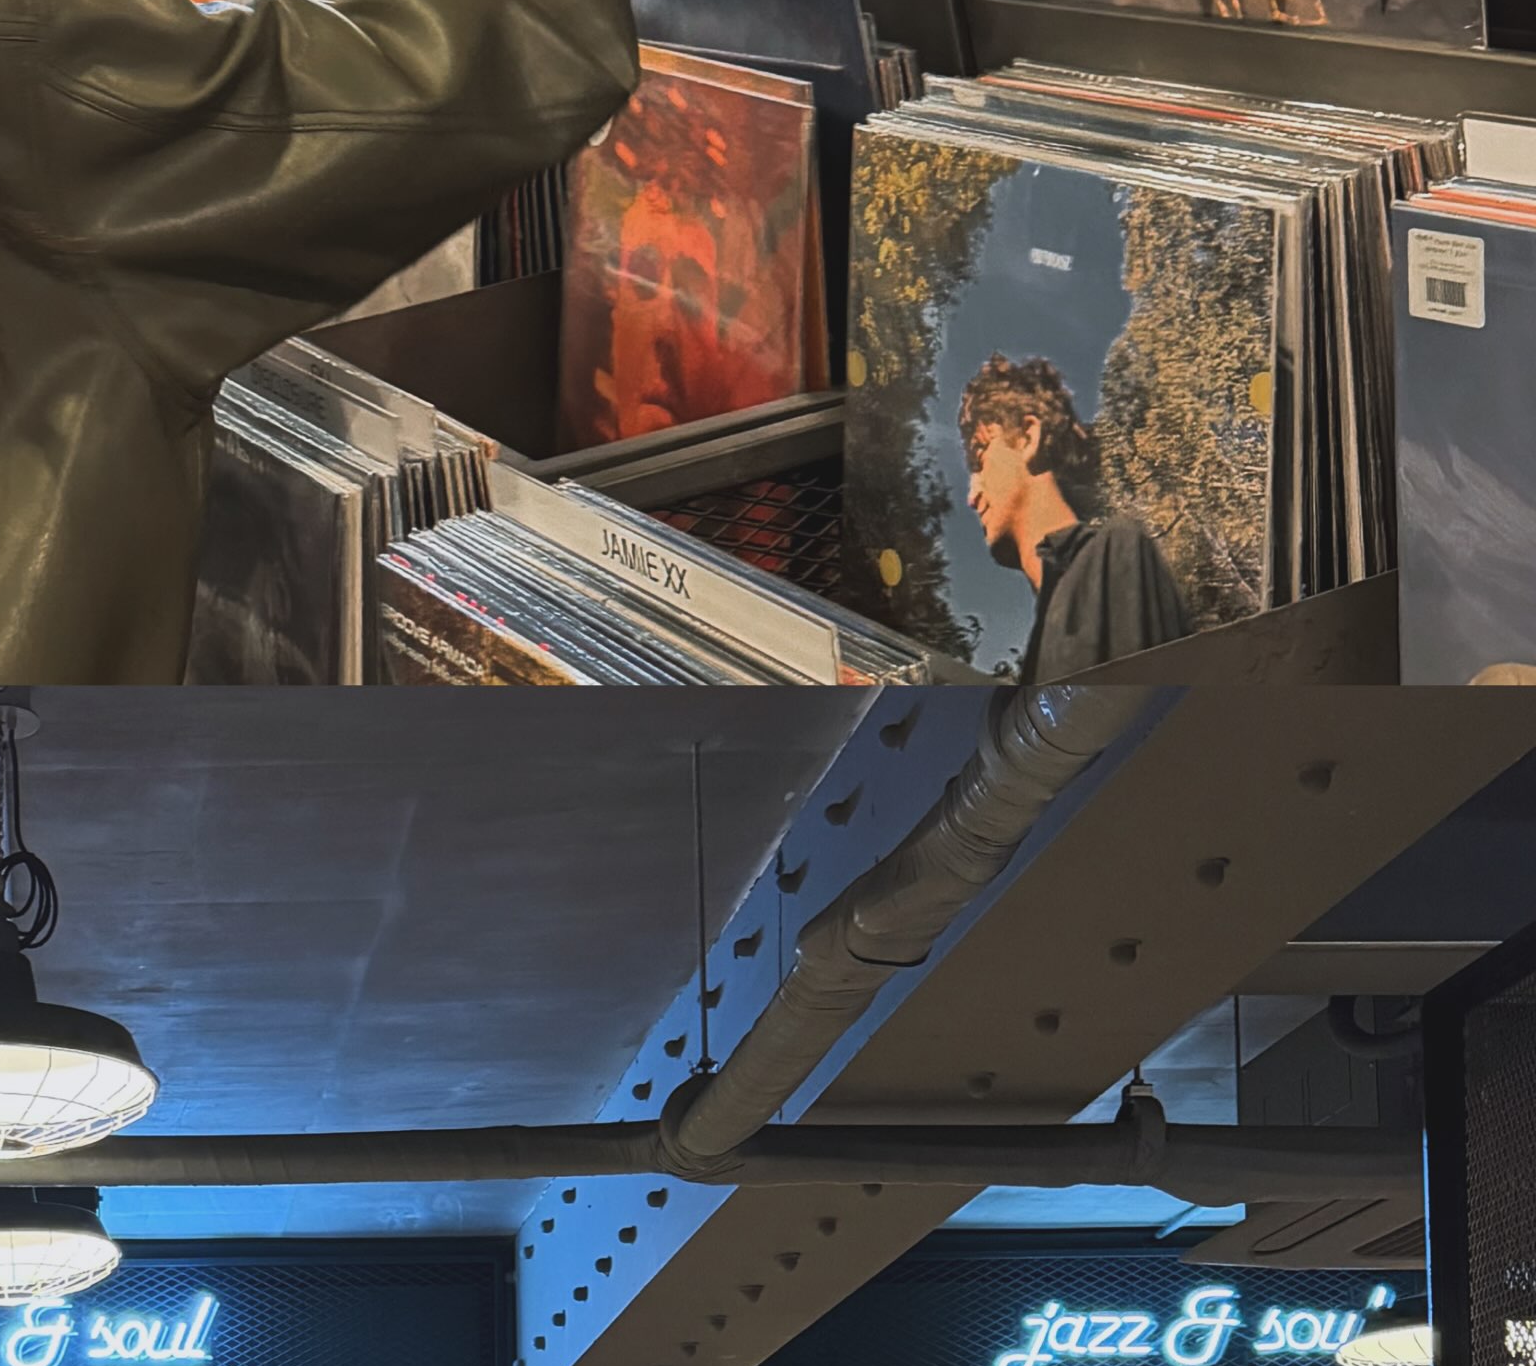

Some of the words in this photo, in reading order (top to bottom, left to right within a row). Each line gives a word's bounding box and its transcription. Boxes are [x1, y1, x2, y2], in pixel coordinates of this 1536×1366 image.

[601, 528, 659, 583] JAMIE
[657, 557, 692, 600] XX
[88, 1291, 217, 1360] soul
